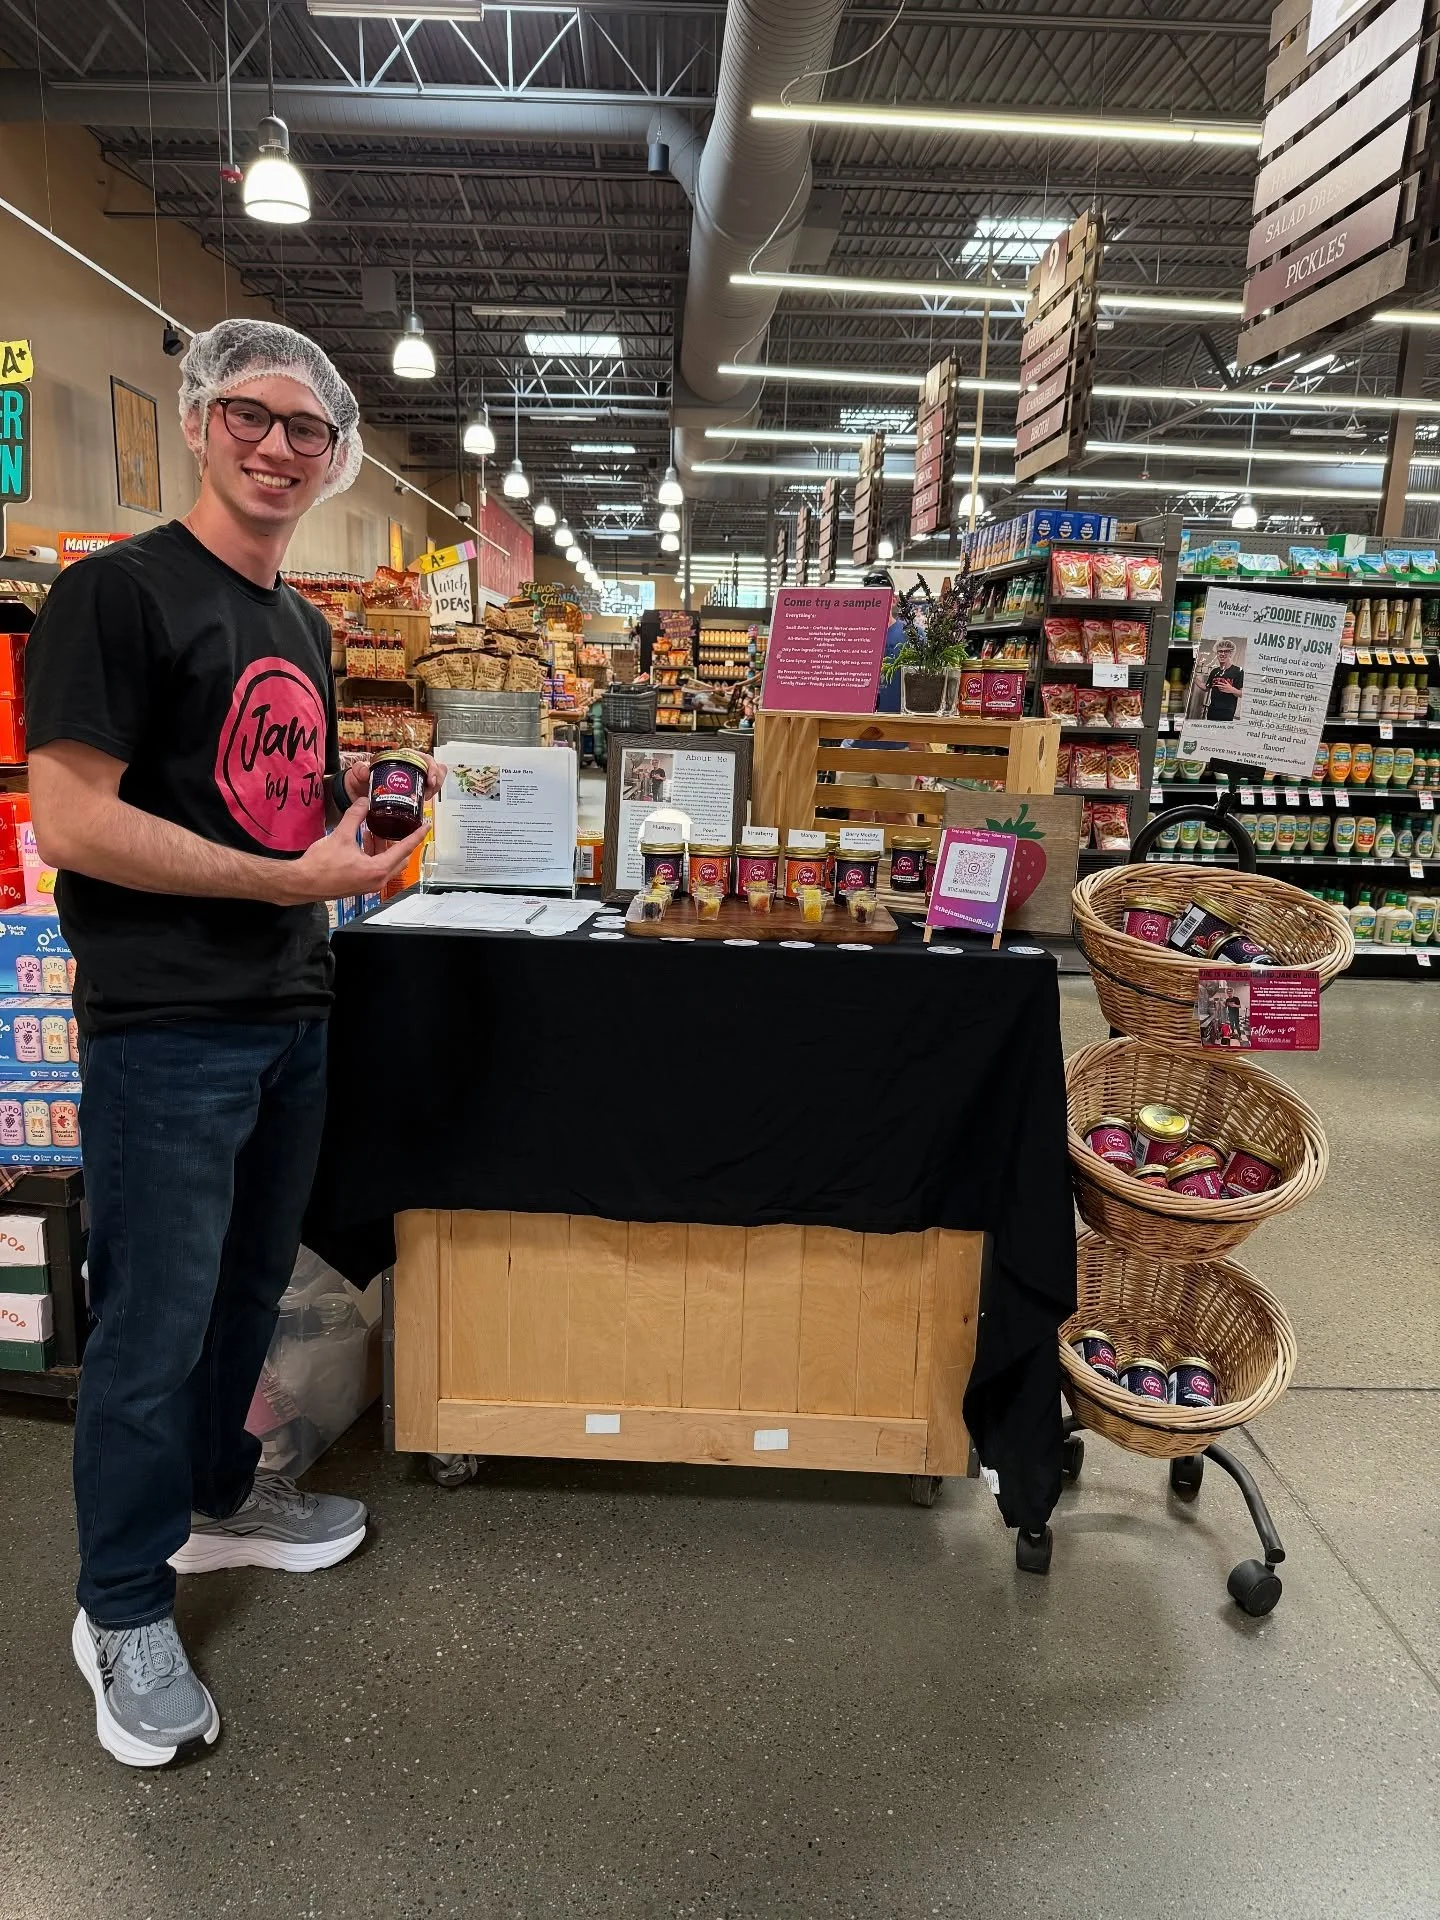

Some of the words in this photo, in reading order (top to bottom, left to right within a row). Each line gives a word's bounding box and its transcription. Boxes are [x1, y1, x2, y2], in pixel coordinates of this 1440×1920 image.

[1265, 203, 1306, 244] SALAD
[1284, 232, 1348, 289] PICKLES
[1, 345, 27, 378] A+
[0, 444, 23, 495] N
[430, 553, 446, 569] A+
[431, 573, 468, 596] lunch
[523, 582, 557, 596] FLAVOR
[435, 597, 470, 614] IDEAS
[540, 593, 563, 608] FALL
[783, 597, 812, 608] Come
[815, 597, 831, 609] try
[842, 598, 882, 610] sample
[1218, 600, 1250, 612] Market
[1265, 606, 1302, 624] FOODIE
[1303, 611, 1337, 629] FINDS
[1219, 610, 1246, 618] DISTRICT
[1254, 632, 1286, 649] JAMS
[1286, 636, 1302, 651] BY
[1303, 639, 1333, 655] JOSH
[1258, 653, 1288, 665] Starting
[1310, 661, 1326, 670] only
[1261, 666, 1283, 674] eleven
[1284, 669, 1304, 677] years
[1305, 671, 1318, 680] old,
[1279, 678, 1306, 689] wanted
[1306, 682, 1314, 690] to
[1253, 687, 1273, 695] make
[1273, 690, 1287, 698] jam
[1287, 691, 1300, 699] the
[1300, 693, 1318, 702] right
[1252, 698, 1268, 706] way.
[1269, 700, 1286, 708] Each
[1287, 702, 1307, 710] batch
[1308, 704, 1315, 712] is
[1250, 708, 1287, 719] handmade
[1288, 711, 1298, 720] by
[1298, 714, 1312, 723] him
[450, 712, 521, 735] DRINKS
[1248, 720, 1265, 728] with
[1265, 721, 1275, 729] no
[240, 703, 319, 772] Jam
[1261, 732, 1277, 740] fruit
[1277, 735, 1292, 743] and
[1292, 737, 1307, 745] real
[1200, 745, 1226, 753] DISCOVER
[1262, 743, 1286, 753] flavor!
[685, 754, 712, 762] About
[390, 774, 408, 784] Jam
[265, 773, 288, 811] by
[800, 832, 818, 840] Mango
[1250, 1025, 1276, 1036] Follow
[0, 1106, 22, 1117] LIPOP
[0, 1233, 26, 1253] POP
[1, 1309, 27, 1328] POP
